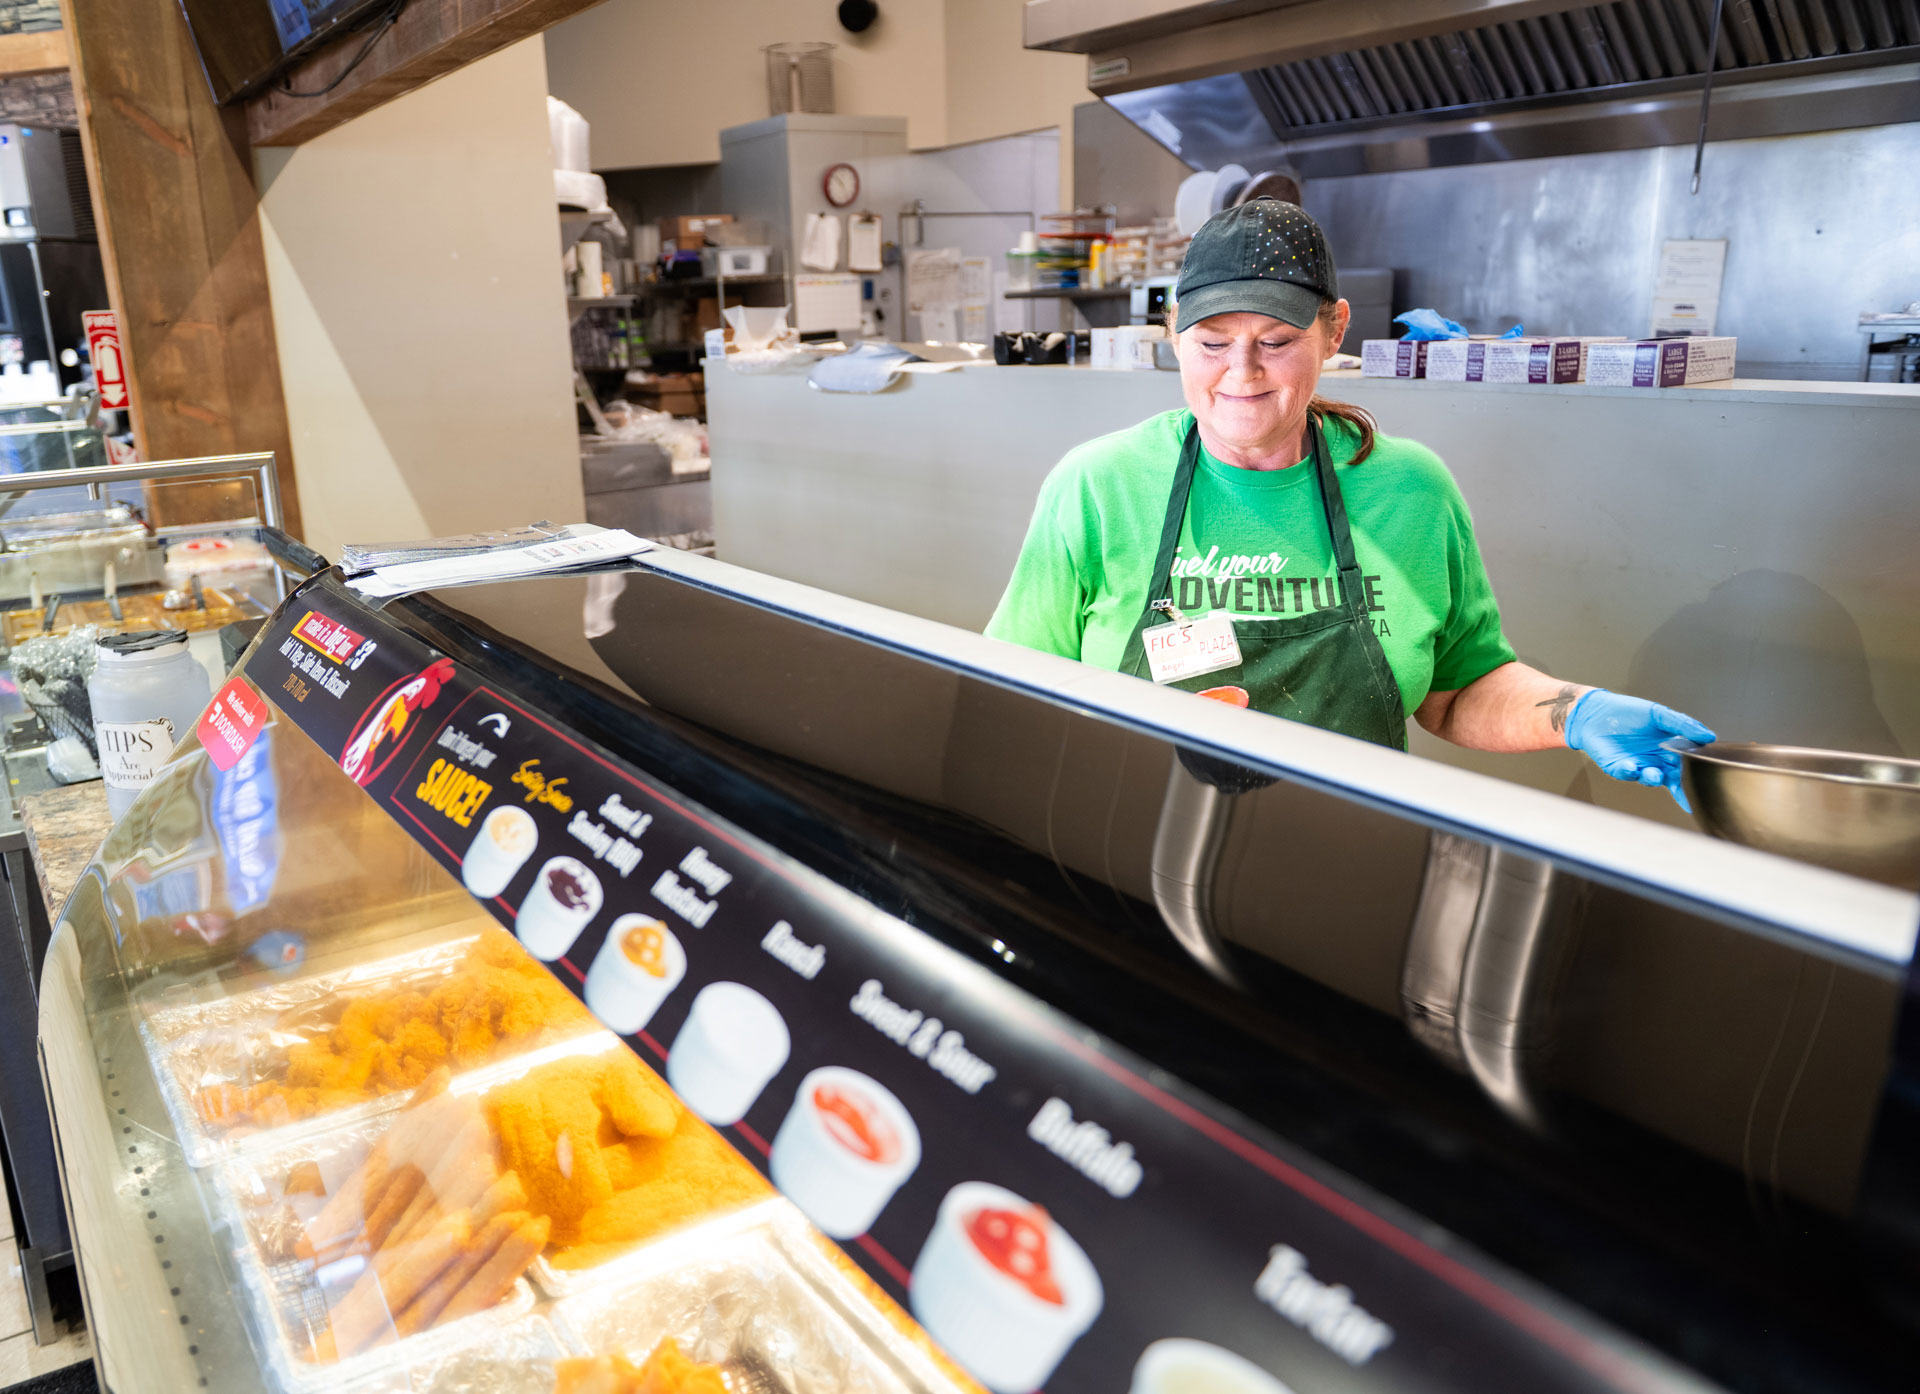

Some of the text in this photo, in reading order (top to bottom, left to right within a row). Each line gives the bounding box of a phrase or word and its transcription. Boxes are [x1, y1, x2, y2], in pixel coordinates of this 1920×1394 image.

[87, 315, 117, 328] FIRE
[1668, 348, 1683, 356] LARGE
[1215, 552, 1289, 584] your
[303, 618, 323, 637] make
[316, 623, 331, 641] it
[324, 624, 348, 655] big
[1151, 629, 1191, 652] FIC'S
[335, 636, 354, 658] box
[350, 639, 377, 671] $3
[1199, 634, 1235, 655] PLAZA
[299, 651, 317, 674] Side
[319, 666, 334, 687] &
[226, 689, 237, 705] We
[324, 669, 351, 700] Biscuit
[231, 697, 247, 719] deliver
[103, 729, 153, 753] TIPS
[214, 712, 247, 756] DOORDASH
[437, 725, 498, 769] Don't forget your
[120, 755, 141, 770] Are
[416, 758, 493, 828] SAUCE!
[598, 793, 653, 839] Sweet &
[604, 836, 644, 878] BBQ
[678, 845, 733, 896] Honey
[650, 869, 719, 929] Mustard
[760, 919, 827, 981] Ranch
[849, 978, 998, 1095] Sweet & Sour
[1026, 1096, 1144, 1199] Buffalo
[1252, 1242, 1397, 1367] Tartar
